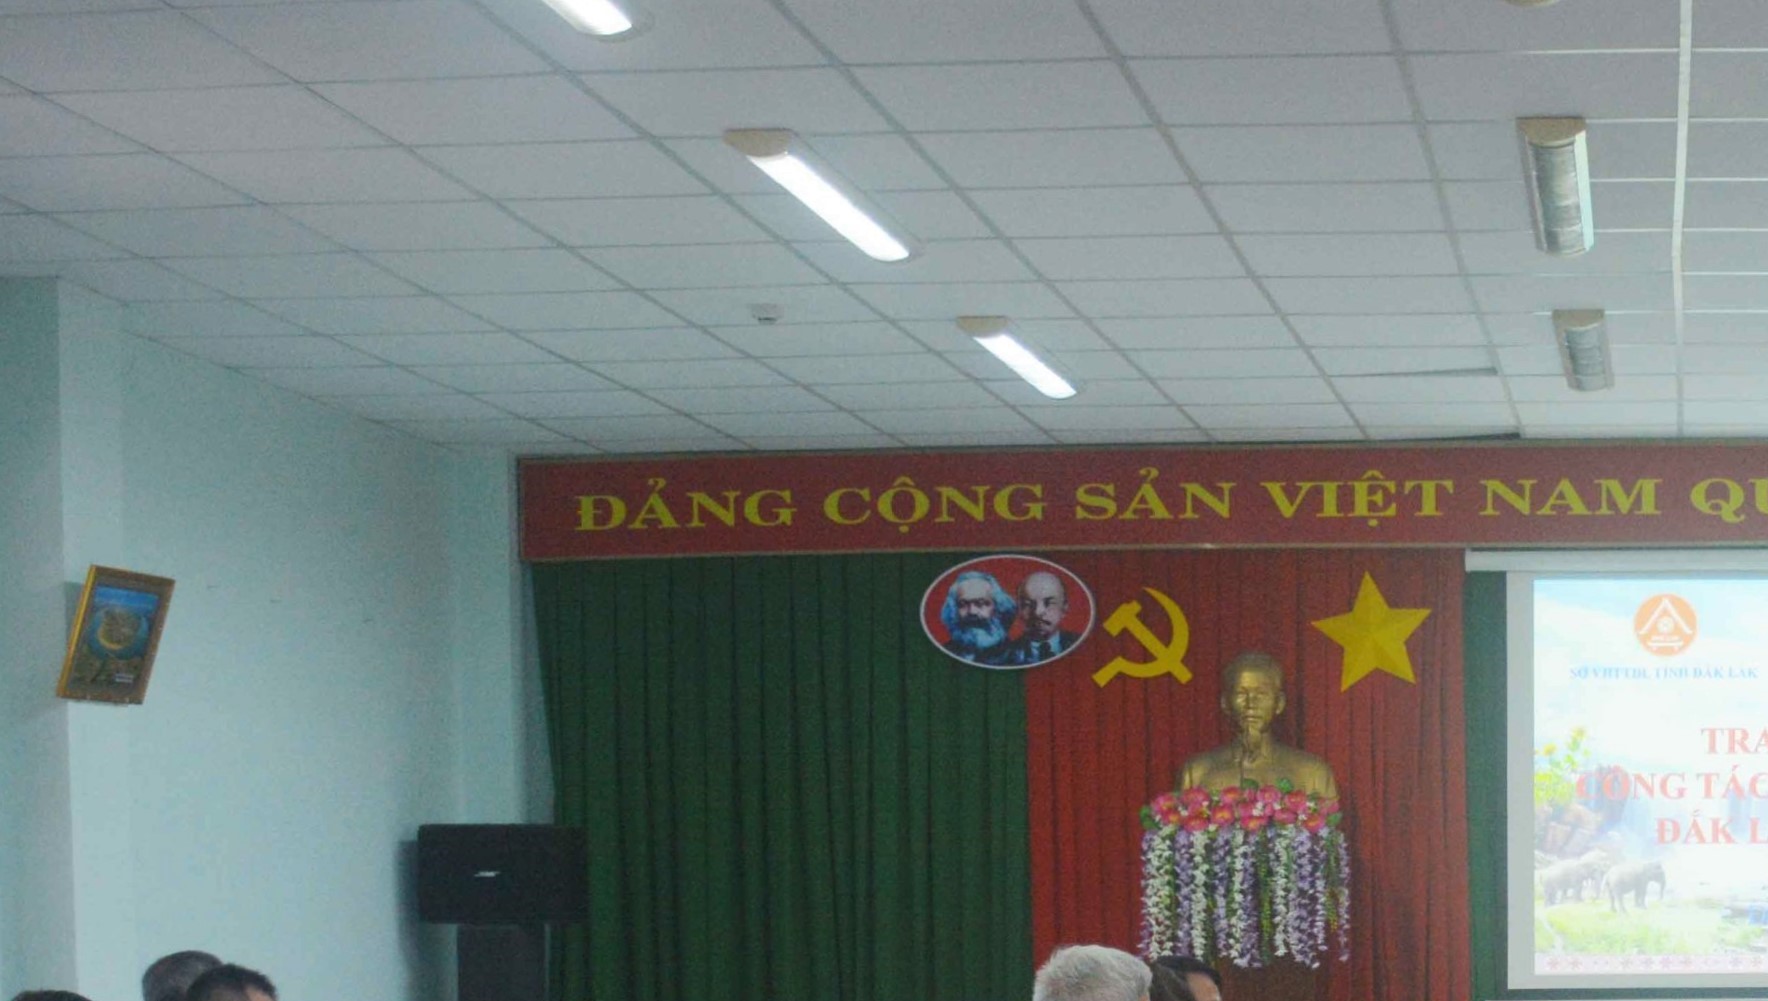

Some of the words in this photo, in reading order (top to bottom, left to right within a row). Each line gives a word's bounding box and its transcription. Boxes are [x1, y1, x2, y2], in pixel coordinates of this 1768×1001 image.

[574, 478, 797, 530] ĐẢNG
[823, 476, 1046, 532] CỘNG
[1075, 467, 1236, 520] SẢN
[1260, 470, 1453, 527] VIỆT
[1478, 478, 1663, 517] NAM
[1575, 765, 1687, 799] CÔNG
